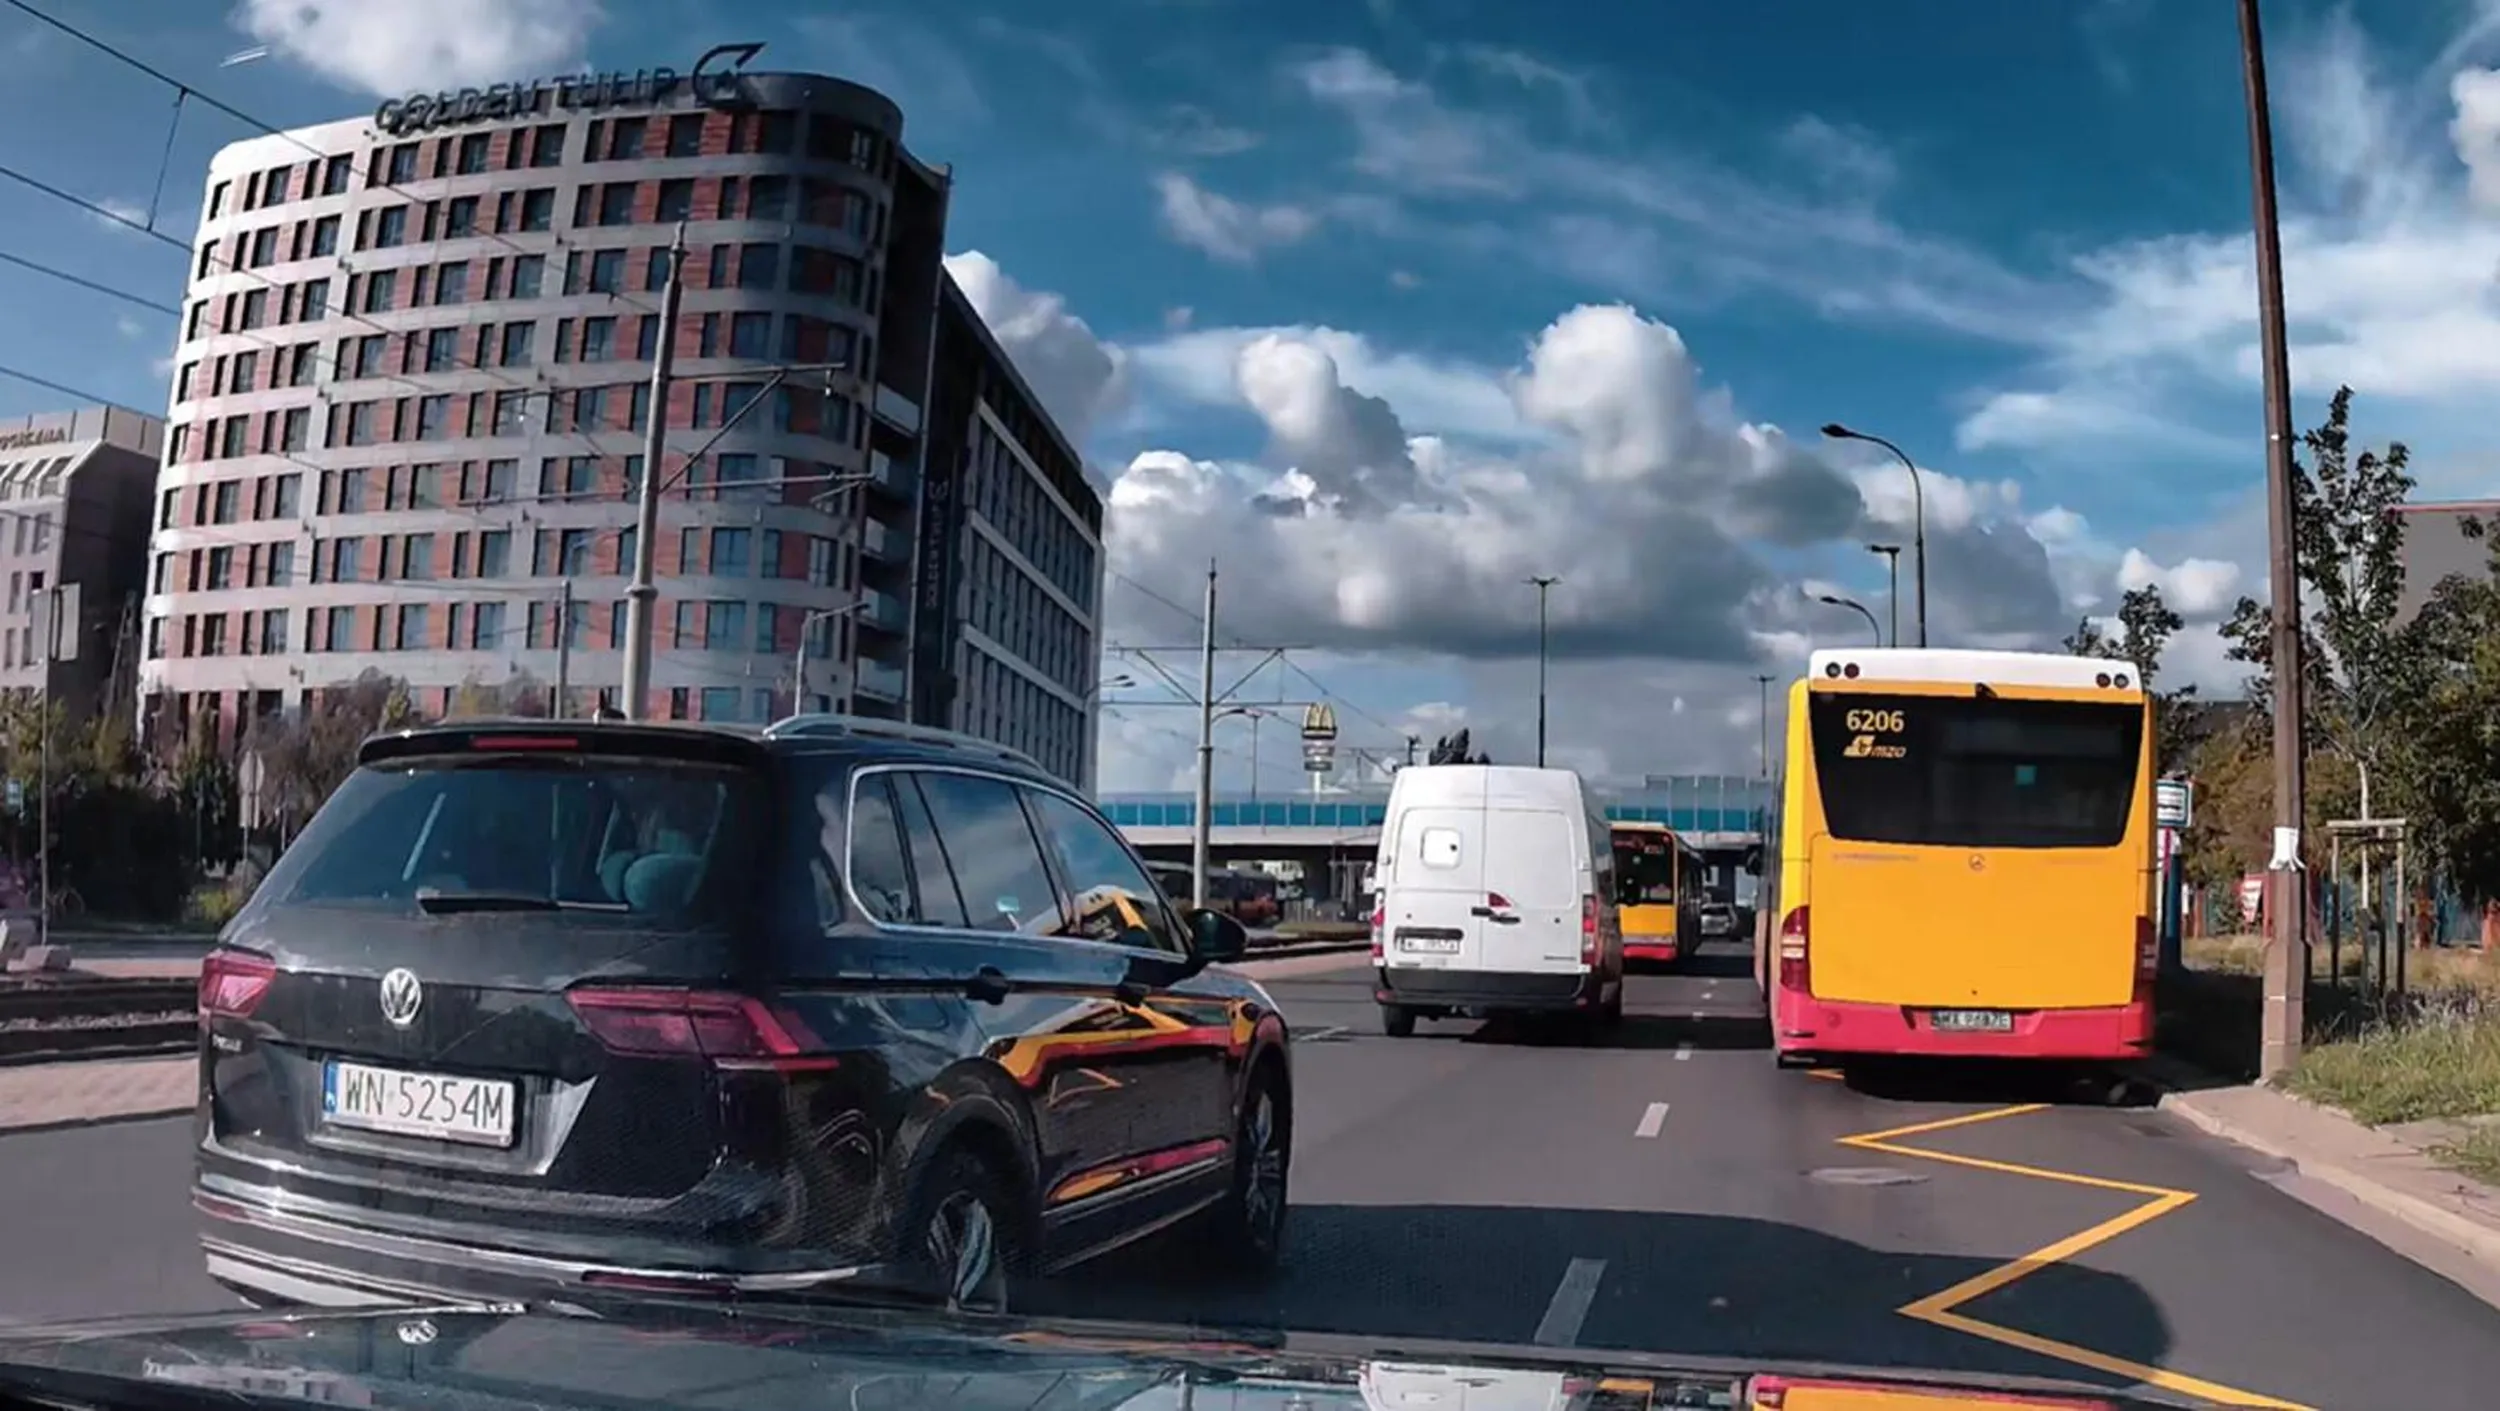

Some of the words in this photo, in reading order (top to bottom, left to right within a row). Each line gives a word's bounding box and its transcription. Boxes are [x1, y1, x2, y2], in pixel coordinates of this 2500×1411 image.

[375, 79, 540, 134] GOLDEN
[552, 67, 677, 108] TULIP
[1846, 709, 1905, 732] 6206
[345, 1070, 386, 1115] WN
[398, 1075, 505, 1130] 5254M
